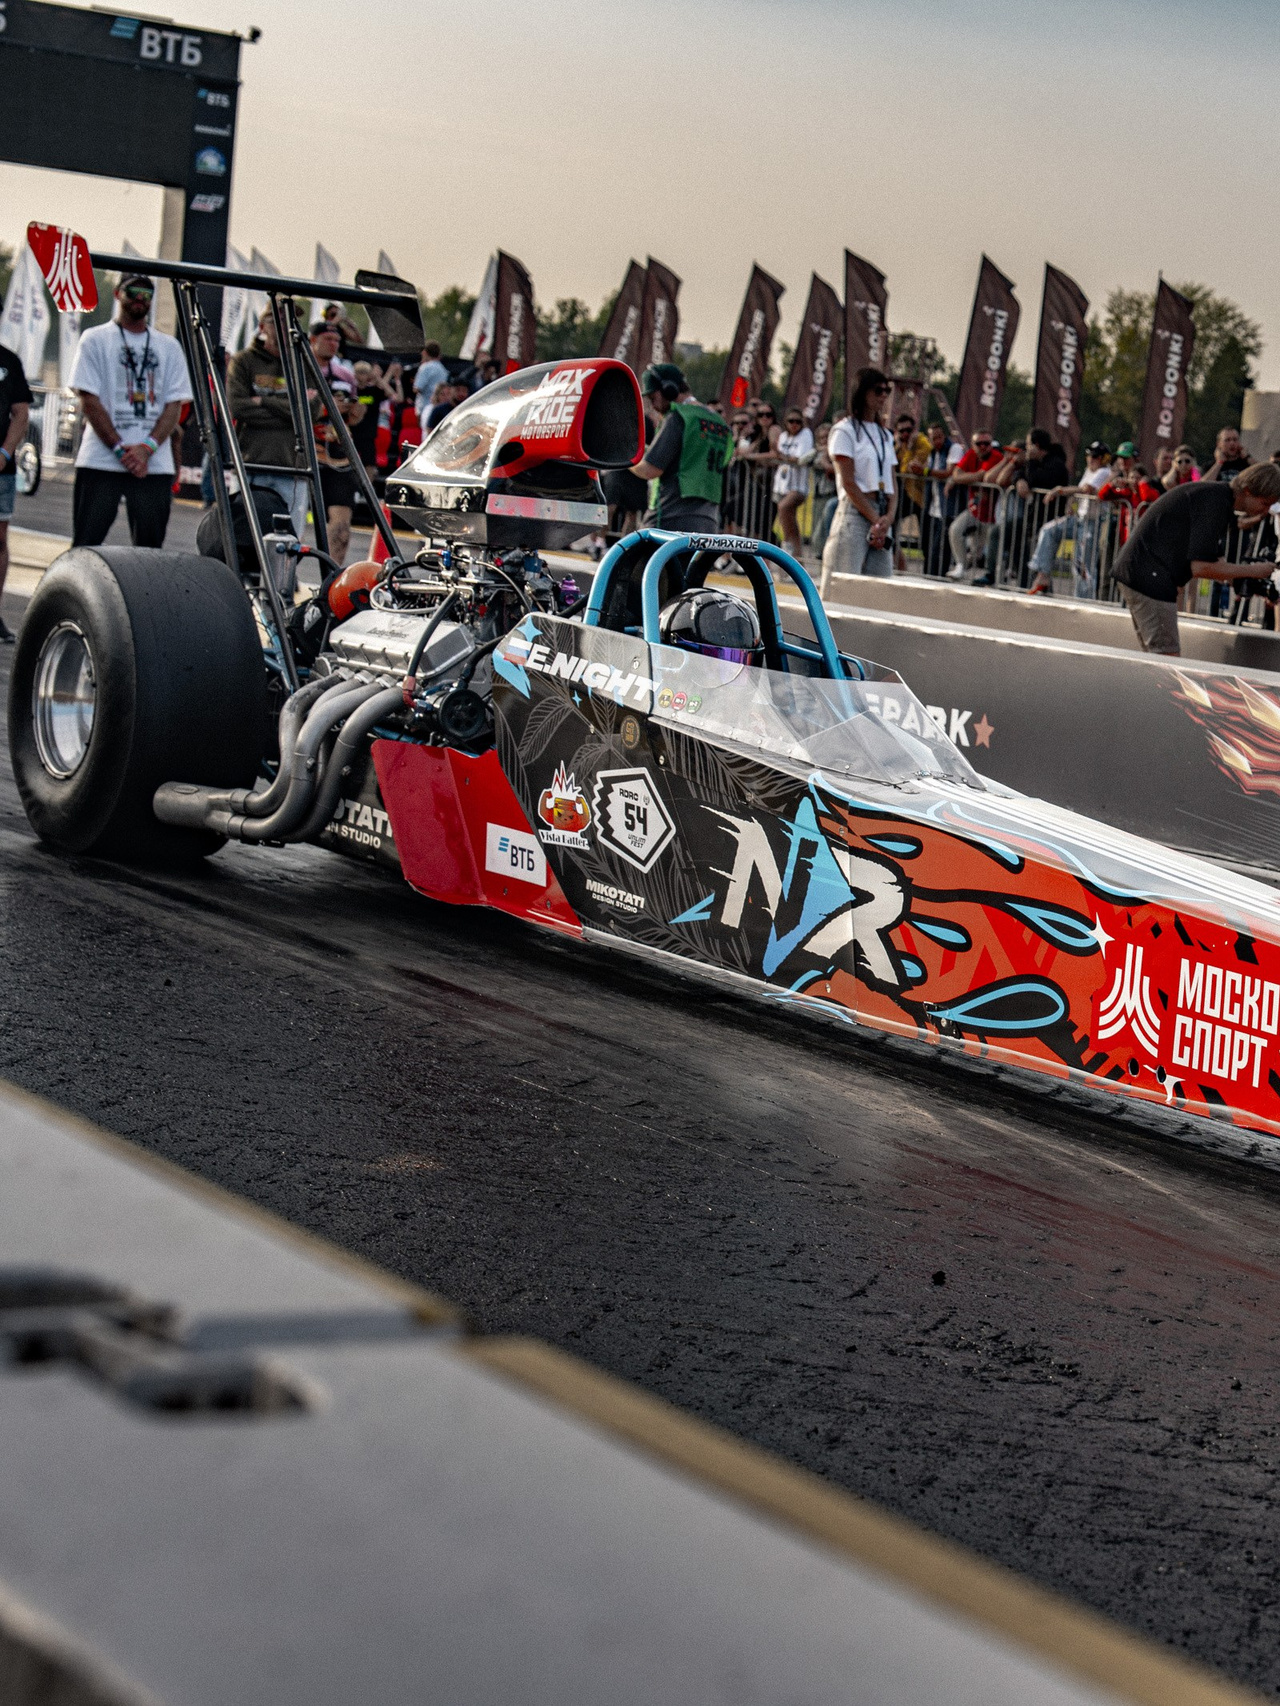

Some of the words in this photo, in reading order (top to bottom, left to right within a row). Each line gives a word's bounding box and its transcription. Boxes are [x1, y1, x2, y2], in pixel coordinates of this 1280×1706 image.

[140, 26, 203, 66] ВТБ
[520, 424, 572, 440] MOTORSPORT
[624, 802, 648, 836] 54
[341, 824, 381, 849] STUDIO
[510, 845, 535, 872] ВТБ
[586, 879, 645, 909] MIKOTATI
[592, 894, 614, 906] DESIGN
[616, 901, 638, 914] STUDIO
[1171, 1013, 1268, 1089] СПОРТ
